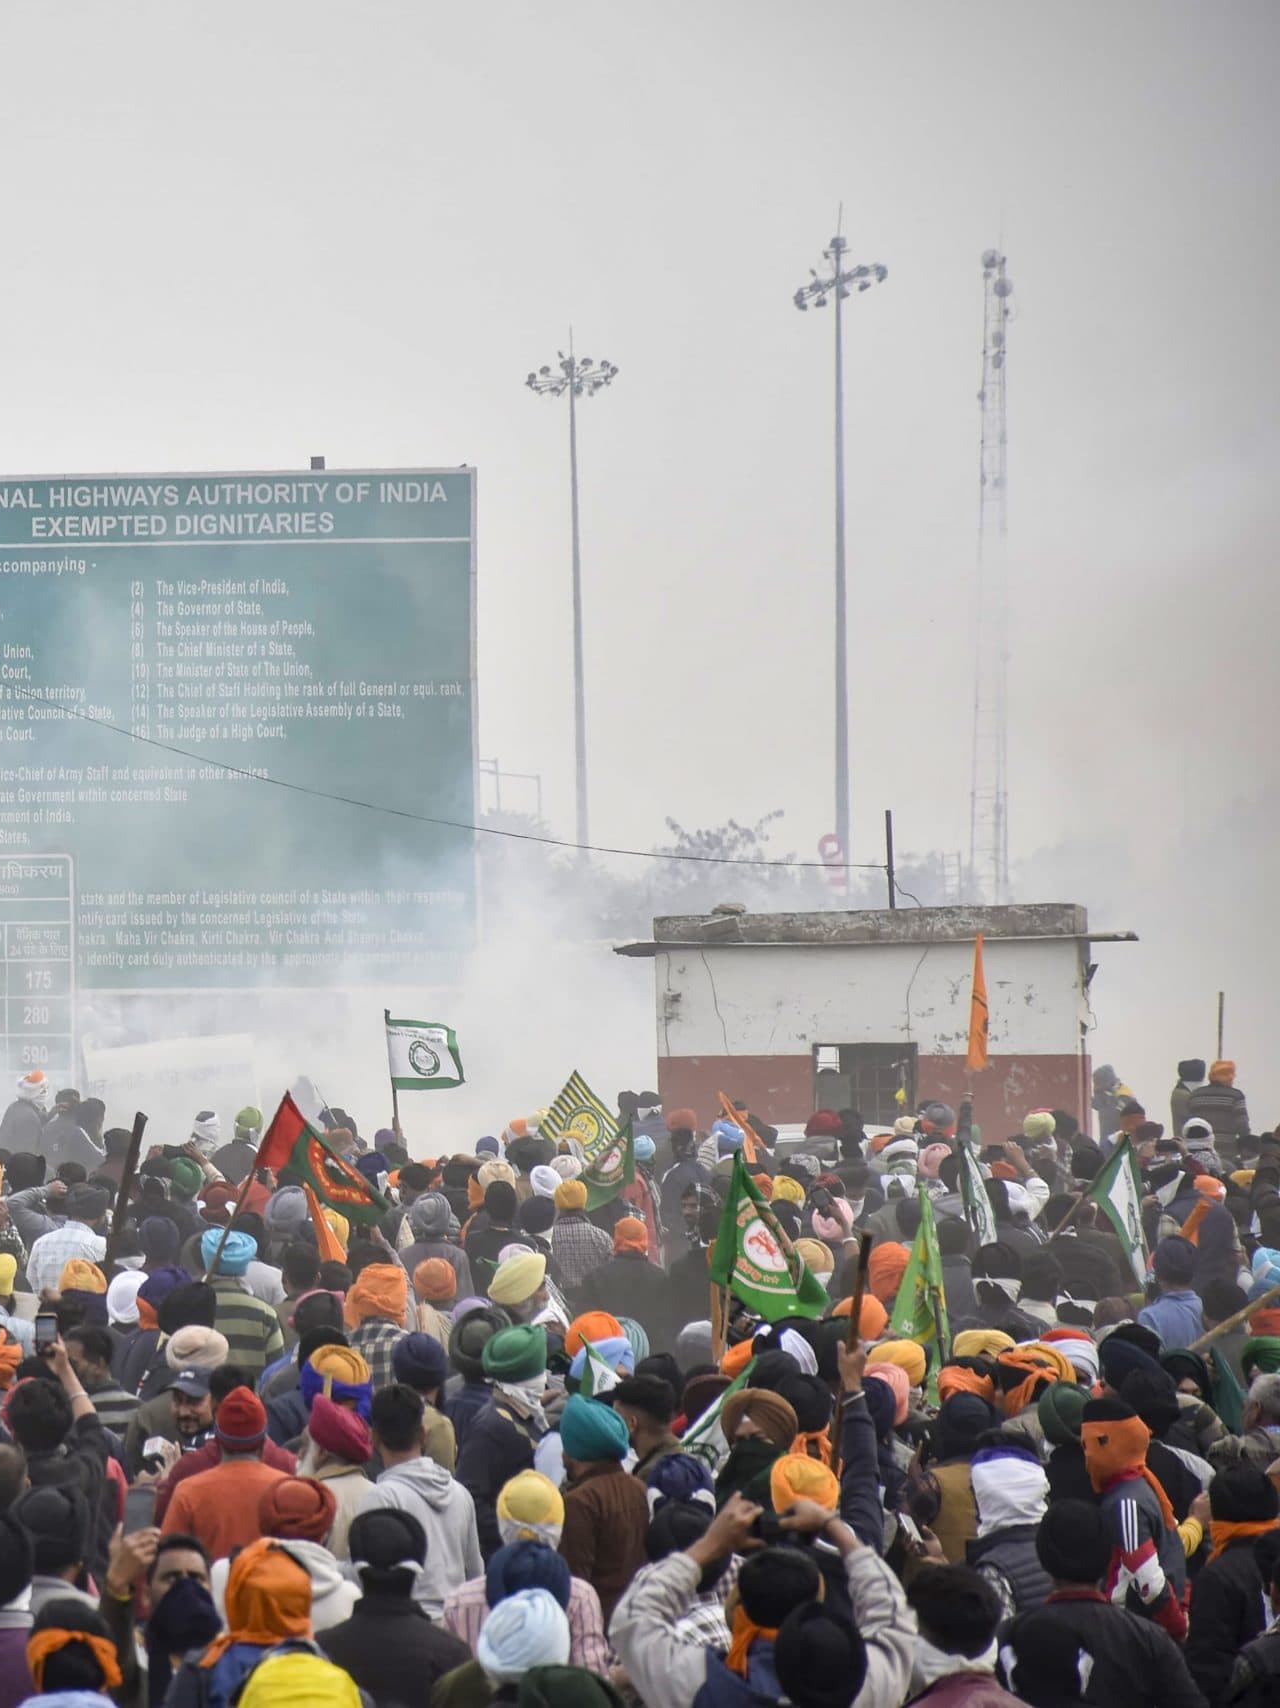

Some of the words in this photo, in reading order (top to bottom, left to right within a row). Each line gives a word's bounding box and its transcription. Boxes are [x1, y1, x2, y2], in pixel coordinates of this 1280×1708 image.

[50, 485, 178, 508] HIGHWAYS
[187, 483, 329, 506] AUTHORITY
[336, 483, 370, 504] OF
[380, 482, 447, 503] INDIA
[32, 515, 168, 538] EXEMPTED
[176, 512, 333, 534] DIGNITARIES
[131, 581, 143, 598] (2)
[157, 580, 173, 596] The
[177, 580, 246, 596] Vice-President
[249, 580, 259, 596] of
[262, 579, 288, 595] India,
[131, 601, 143, 618] (4)
[157, 601, 173, 617] The
[177, 601, 221, 617] Governor
[225, 601, 234, 617] of
[237, 600, 263, 616] State,
[4, 646, 34, 660] Union,
[2, 666, 31, 681] Court,
[6, 727, 34, 741] Court,
[25, 970, 52, 990] 175
[23, 1006, 49, 1026] 280
[22, 1045, 49, 1065] 590
